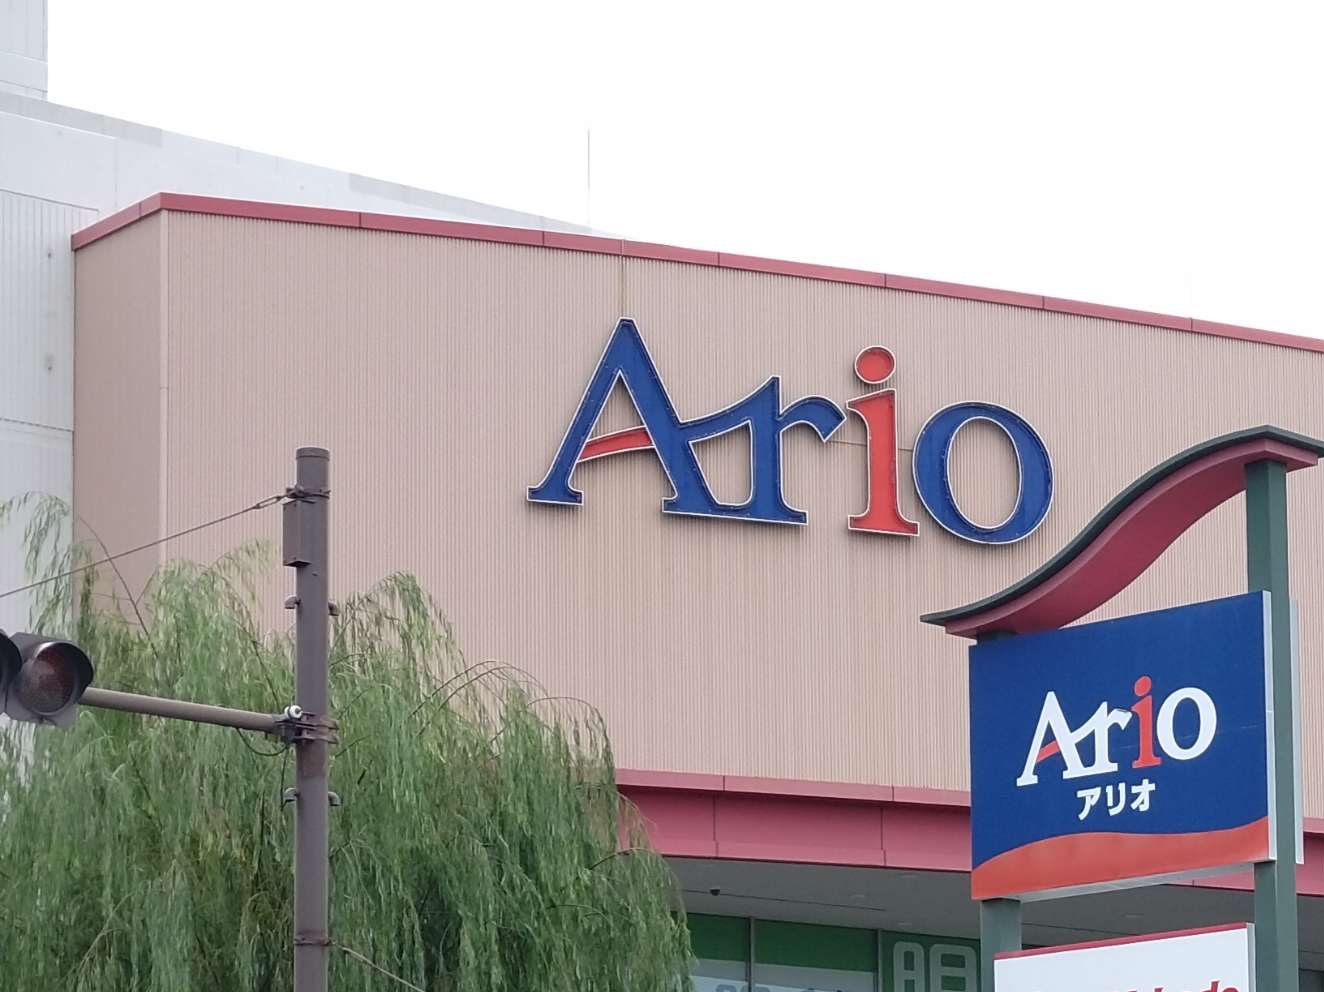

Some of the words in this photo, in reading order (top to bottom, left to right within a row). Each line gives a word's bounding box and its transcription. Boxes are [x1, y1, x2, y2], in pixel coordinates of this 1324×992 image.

[527, 316, 1054, 544] Ario
[1016, 676, 1217, 787] Ario
[1077, 779, 1156, 820] アリオ
